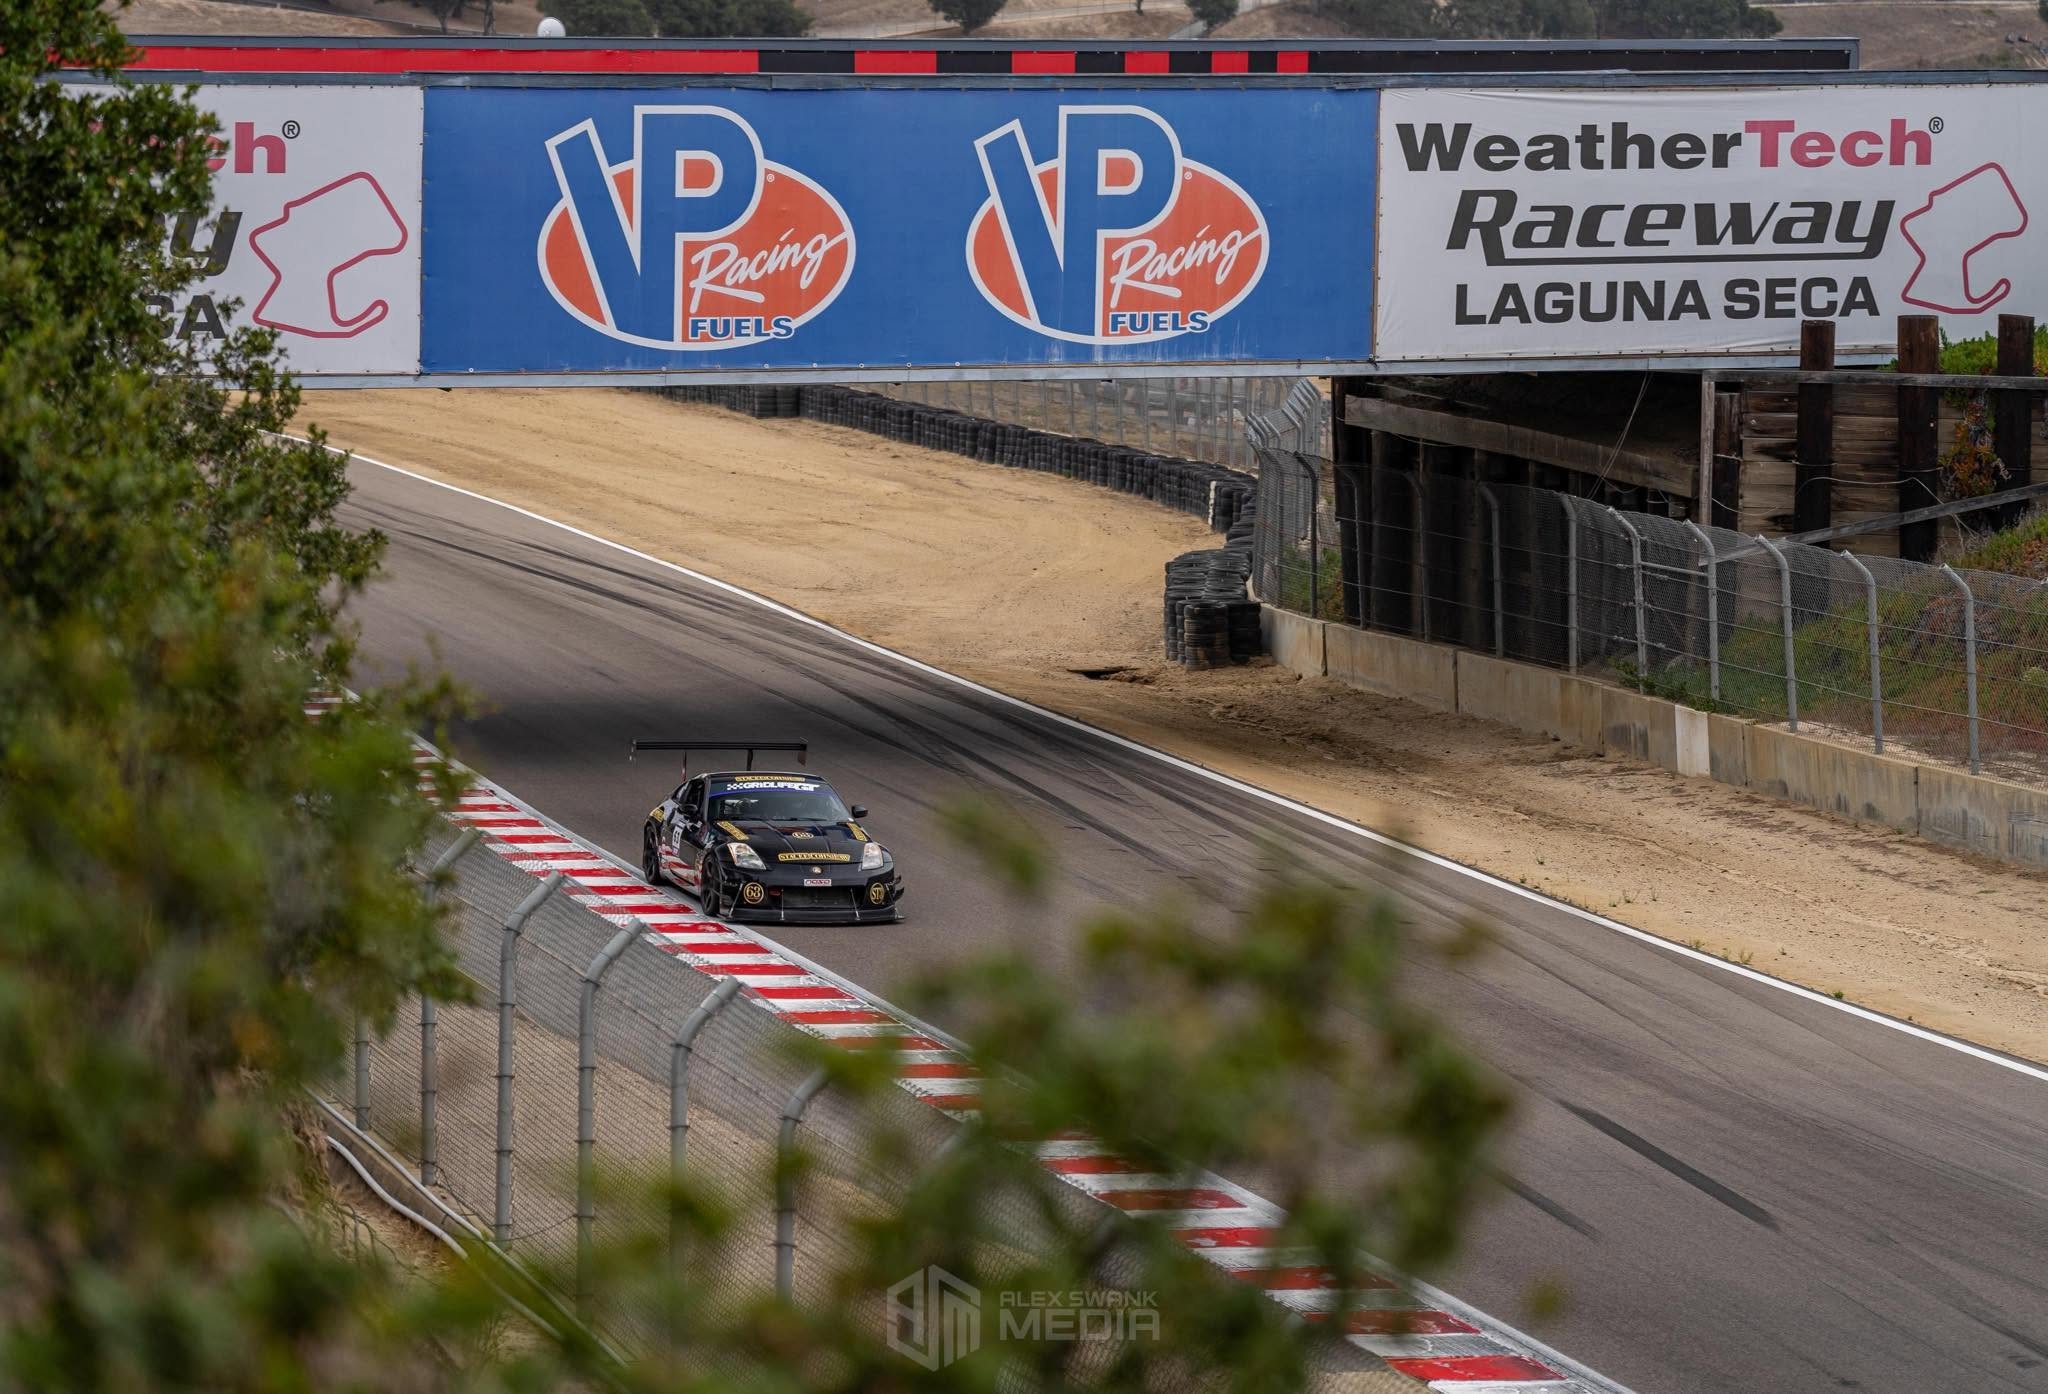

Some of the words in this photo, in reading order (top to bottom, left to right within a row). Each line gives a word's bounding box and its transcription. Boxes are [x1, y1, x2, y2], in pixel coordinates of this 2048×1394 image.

[1396, 118, 1932, 173] WeatherTech
[545, 105, 765, 342] VP
[974, 105, 1183, 339] VP
[1446, 188, 1896, 266] Raceway
[689, 227, 847, 313] Racing
[1110, 225, 1266, 313] Racing
[1454, 277, 1711, 326] LAGUNA
[1724, 276, 1881, 319] SECA
[688, 316, 795, 341] FUELS
[1108, 310, 1212, 334] FUELS
[746, 885, 761, 898] 63
